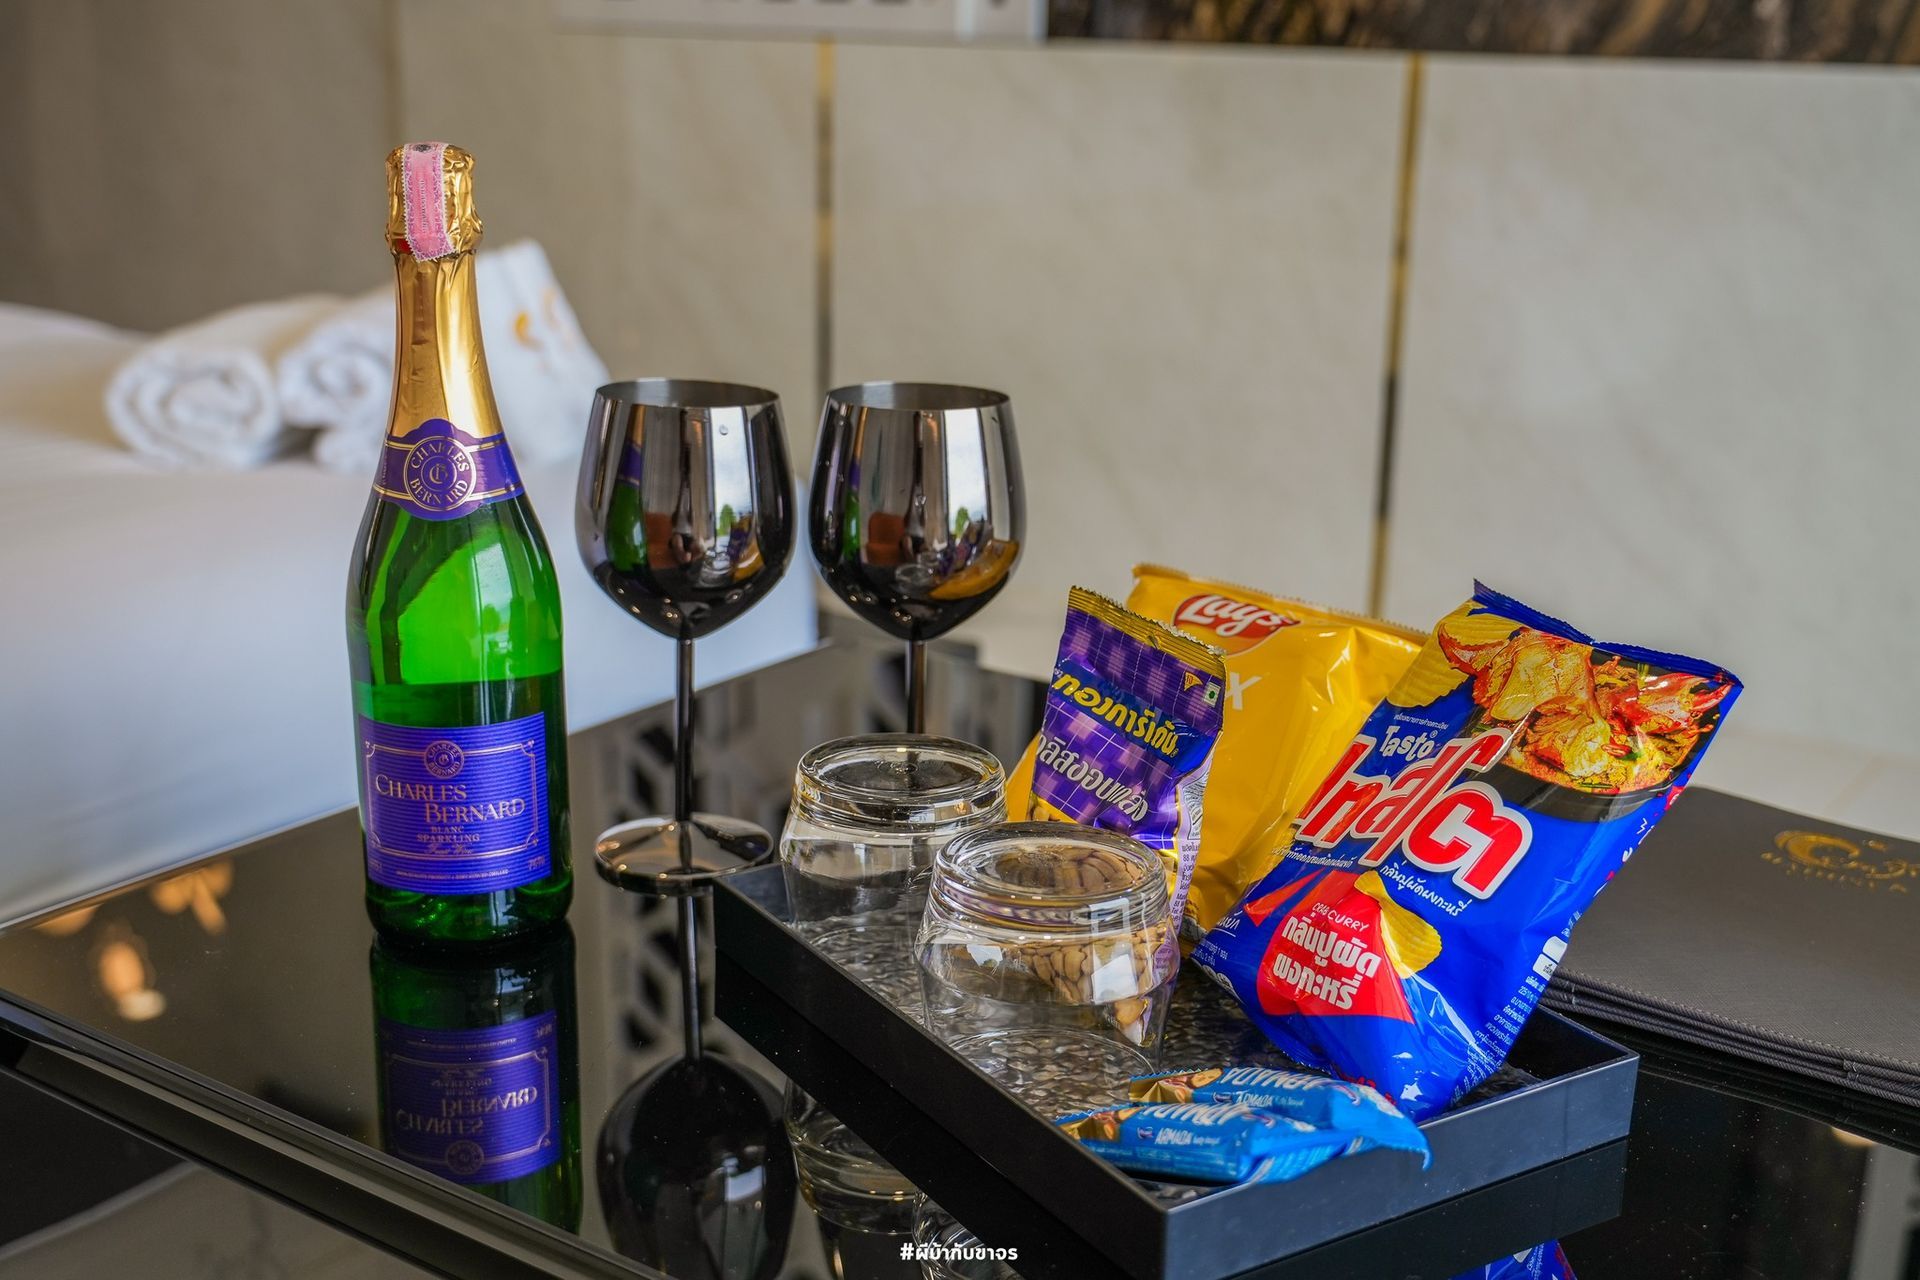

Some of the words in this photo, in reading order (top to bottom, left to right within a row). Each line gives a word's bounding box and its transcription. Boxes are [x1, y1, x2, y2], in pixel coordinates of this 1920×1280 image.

[375, 774, 468, 801] CHARLES
[424, 798, 526, 823] BERNARD
[416, 833, 480, 842] SPARKLING
[1380, 860, 1472, 917] กลิ่นปูผัดผงกะหรี่
[1327, 911, 1369, 932] CURRY
[1282, 912, 1382, 979] กลิ่นปูผัด
[1272, 953, 1364, 1010] ผงกะหรี่
